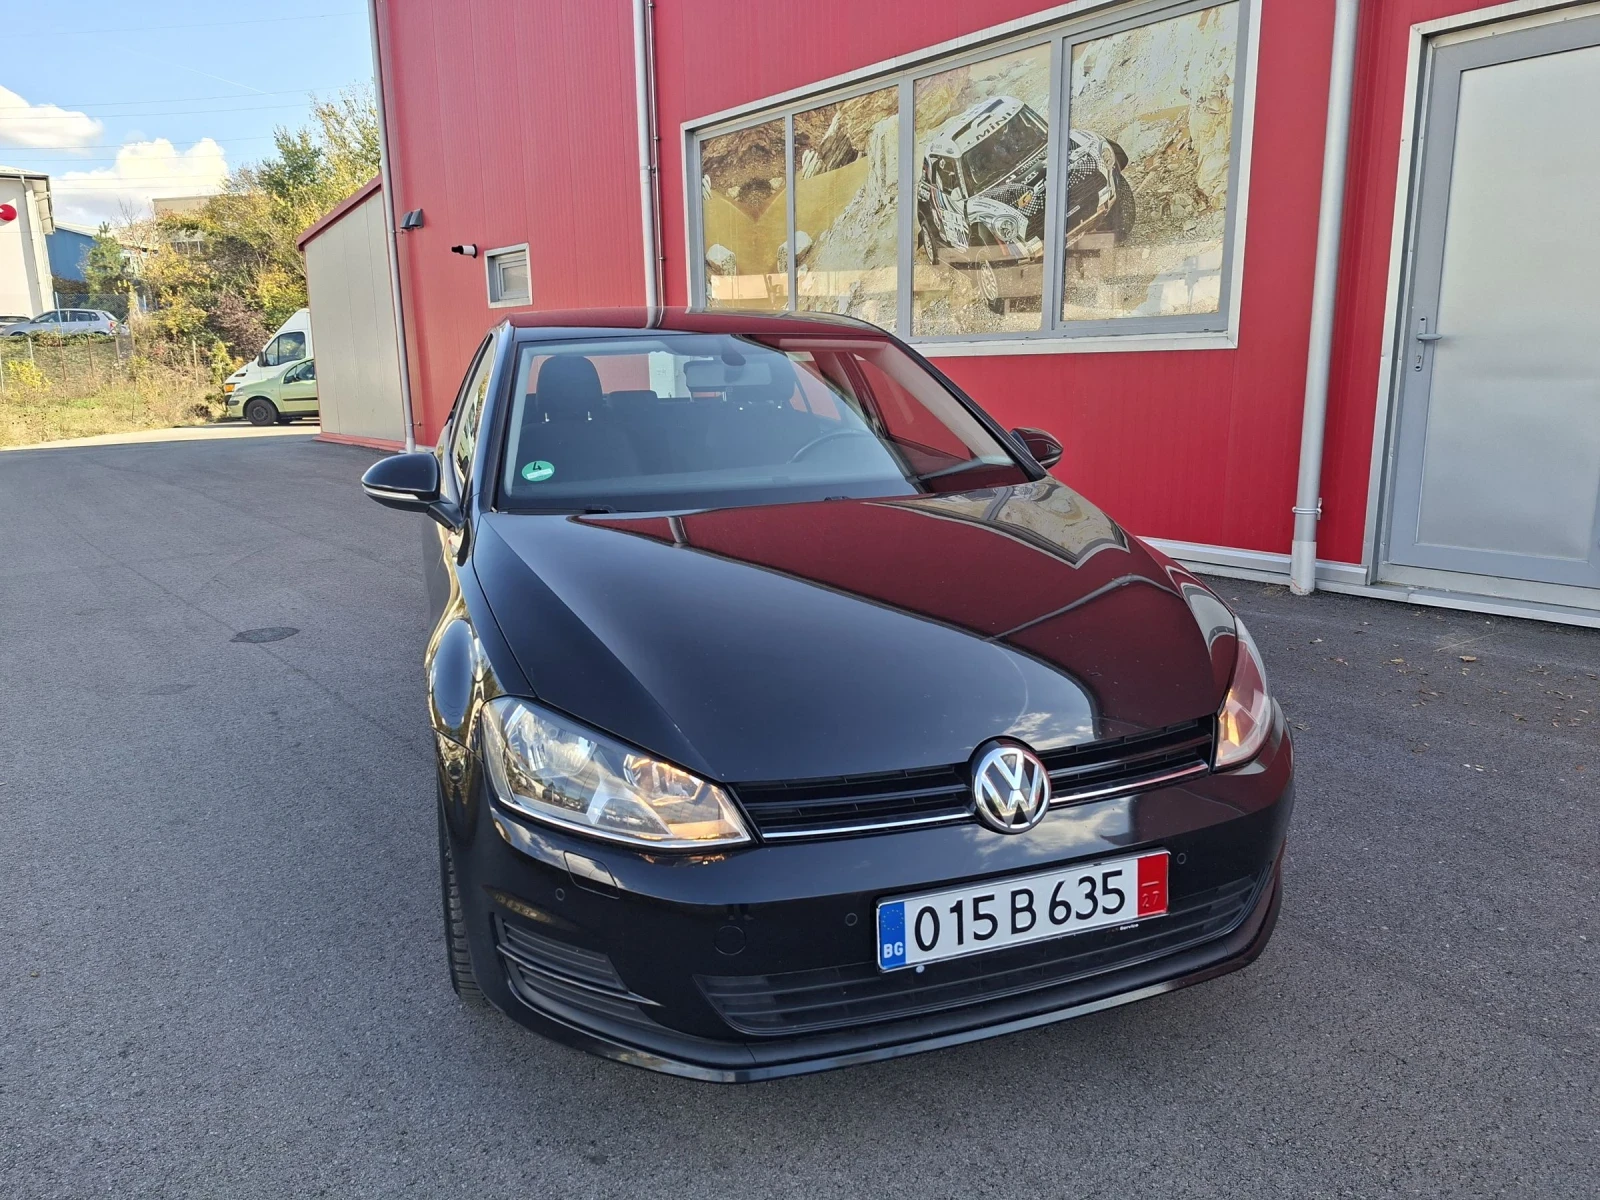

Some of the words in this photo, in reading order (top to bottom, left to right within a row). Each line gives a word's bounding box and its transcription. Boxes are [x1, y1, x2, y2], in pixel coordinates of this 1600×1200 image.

[533, 462, 542, 471] 4
[914, 894, 998, 952] 015
[1010, 888, 1037, 934] B
[1048, 869, 1126, 925] 635
[883, 941, 904, 959] BG
